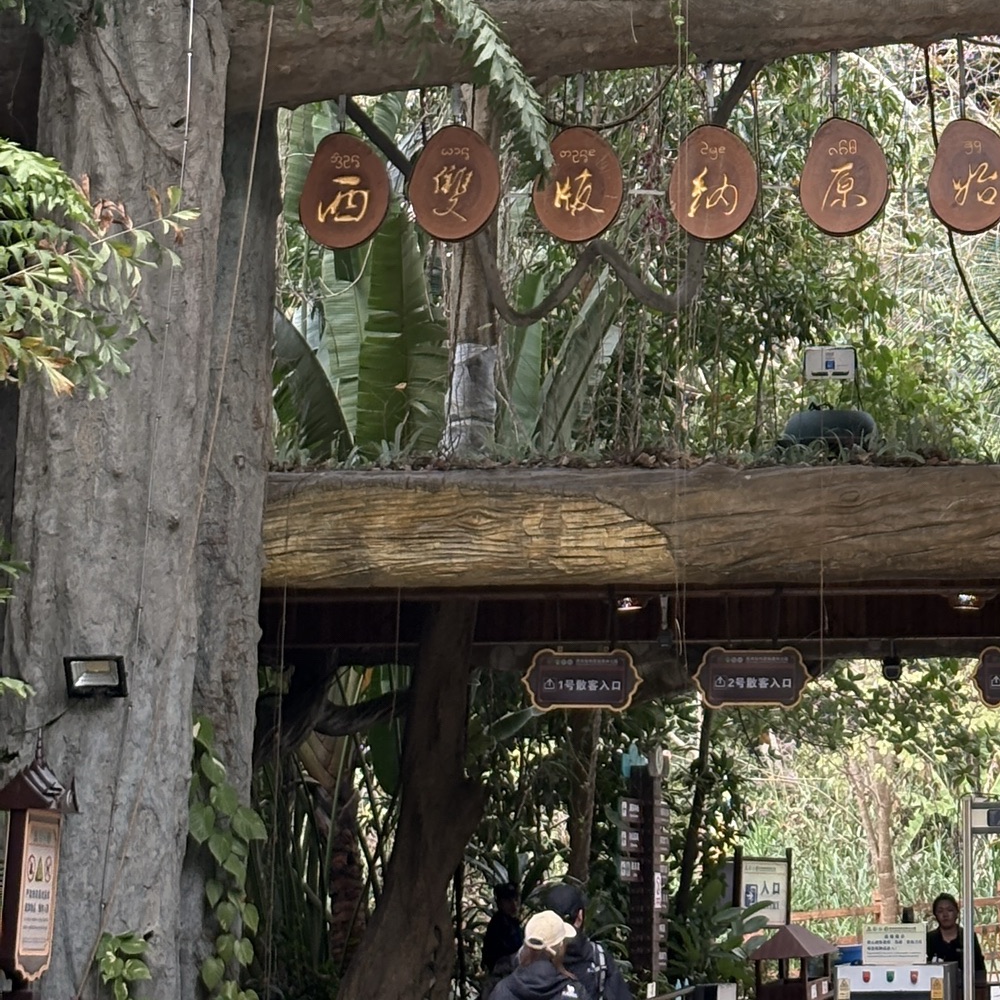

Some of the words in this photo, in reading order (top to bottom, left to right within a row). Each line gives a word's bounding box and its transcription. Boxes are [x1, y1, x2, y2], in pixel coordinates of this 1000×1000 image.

[557, 679, 622, 691] 1号散客入口
[727, 677, 792, 689] 2号散客入口
[760, 880, 780, 895] 入口
